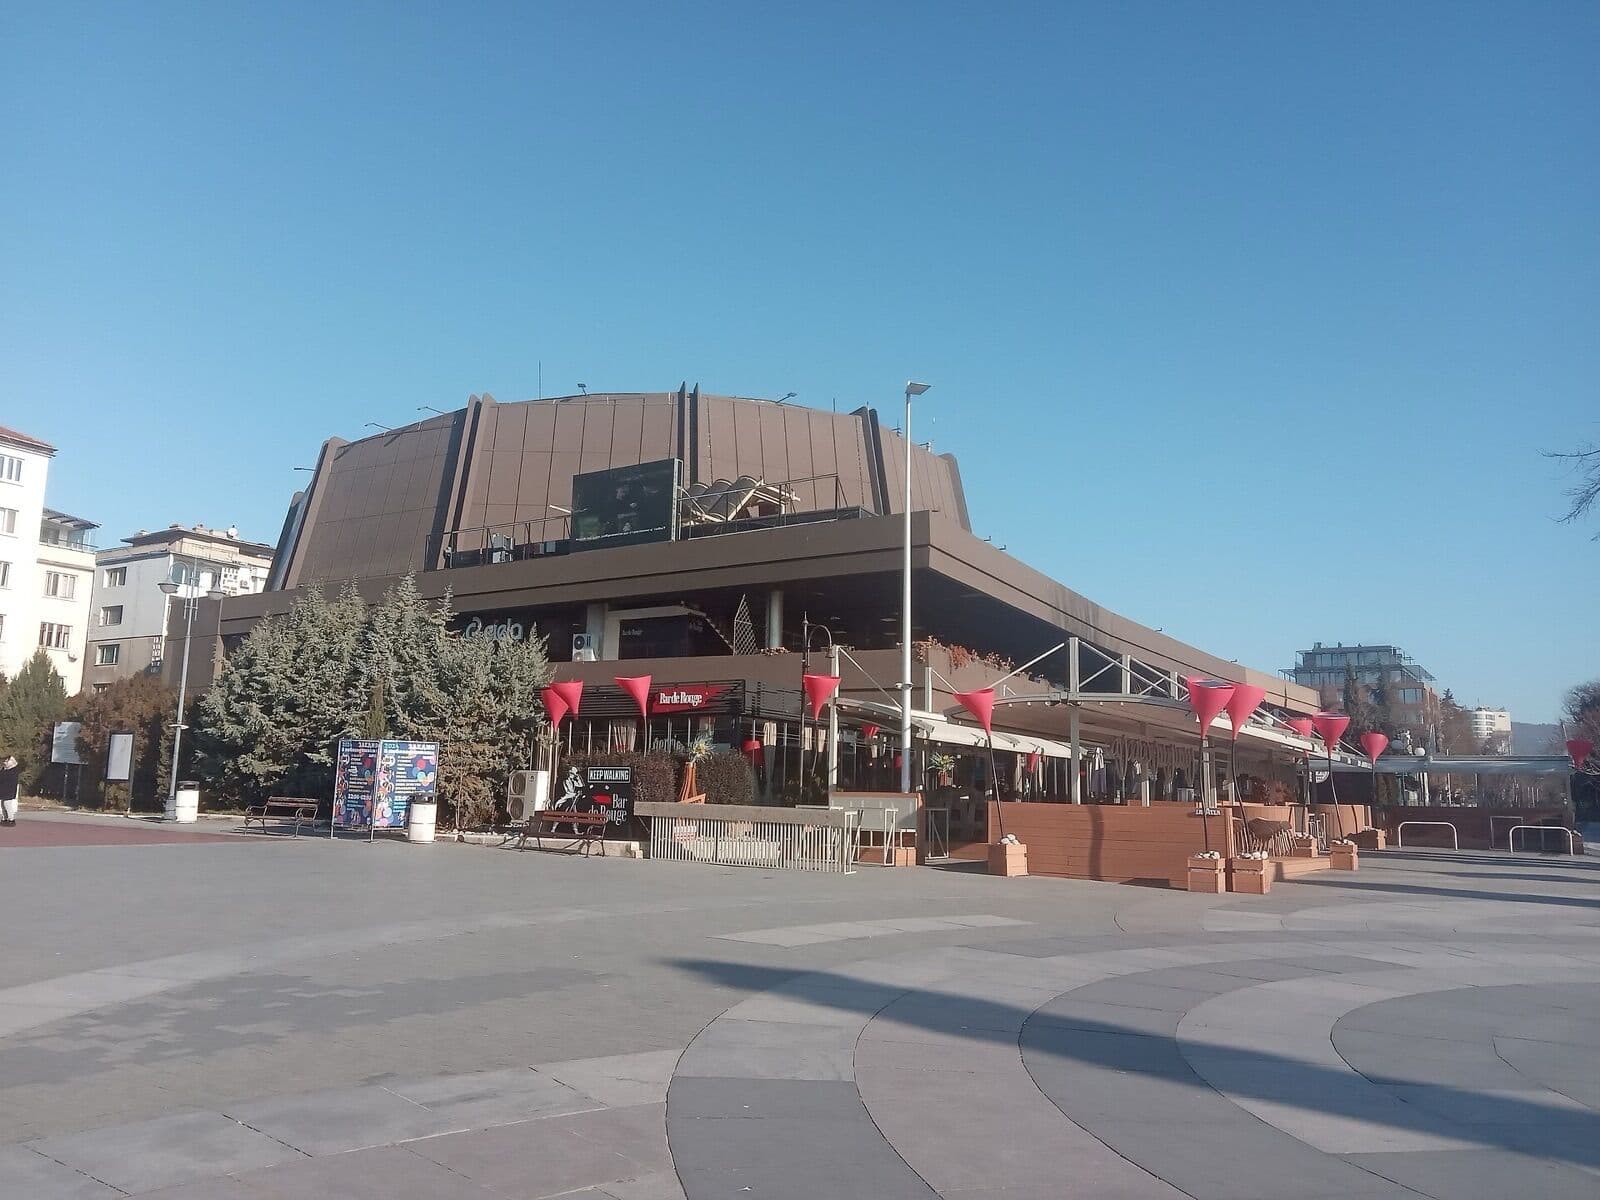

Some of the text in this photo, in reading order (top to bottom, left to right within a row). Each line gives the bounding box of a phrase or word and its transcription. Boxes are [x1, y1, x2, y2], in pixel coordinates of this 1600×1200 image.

[680, 692, 702, 706] Rouge
[590, 770, 628, 780] KEEP WALKING
[613, 794, 628, 808] Bar
[601, 805, 627, 825] Rouge
